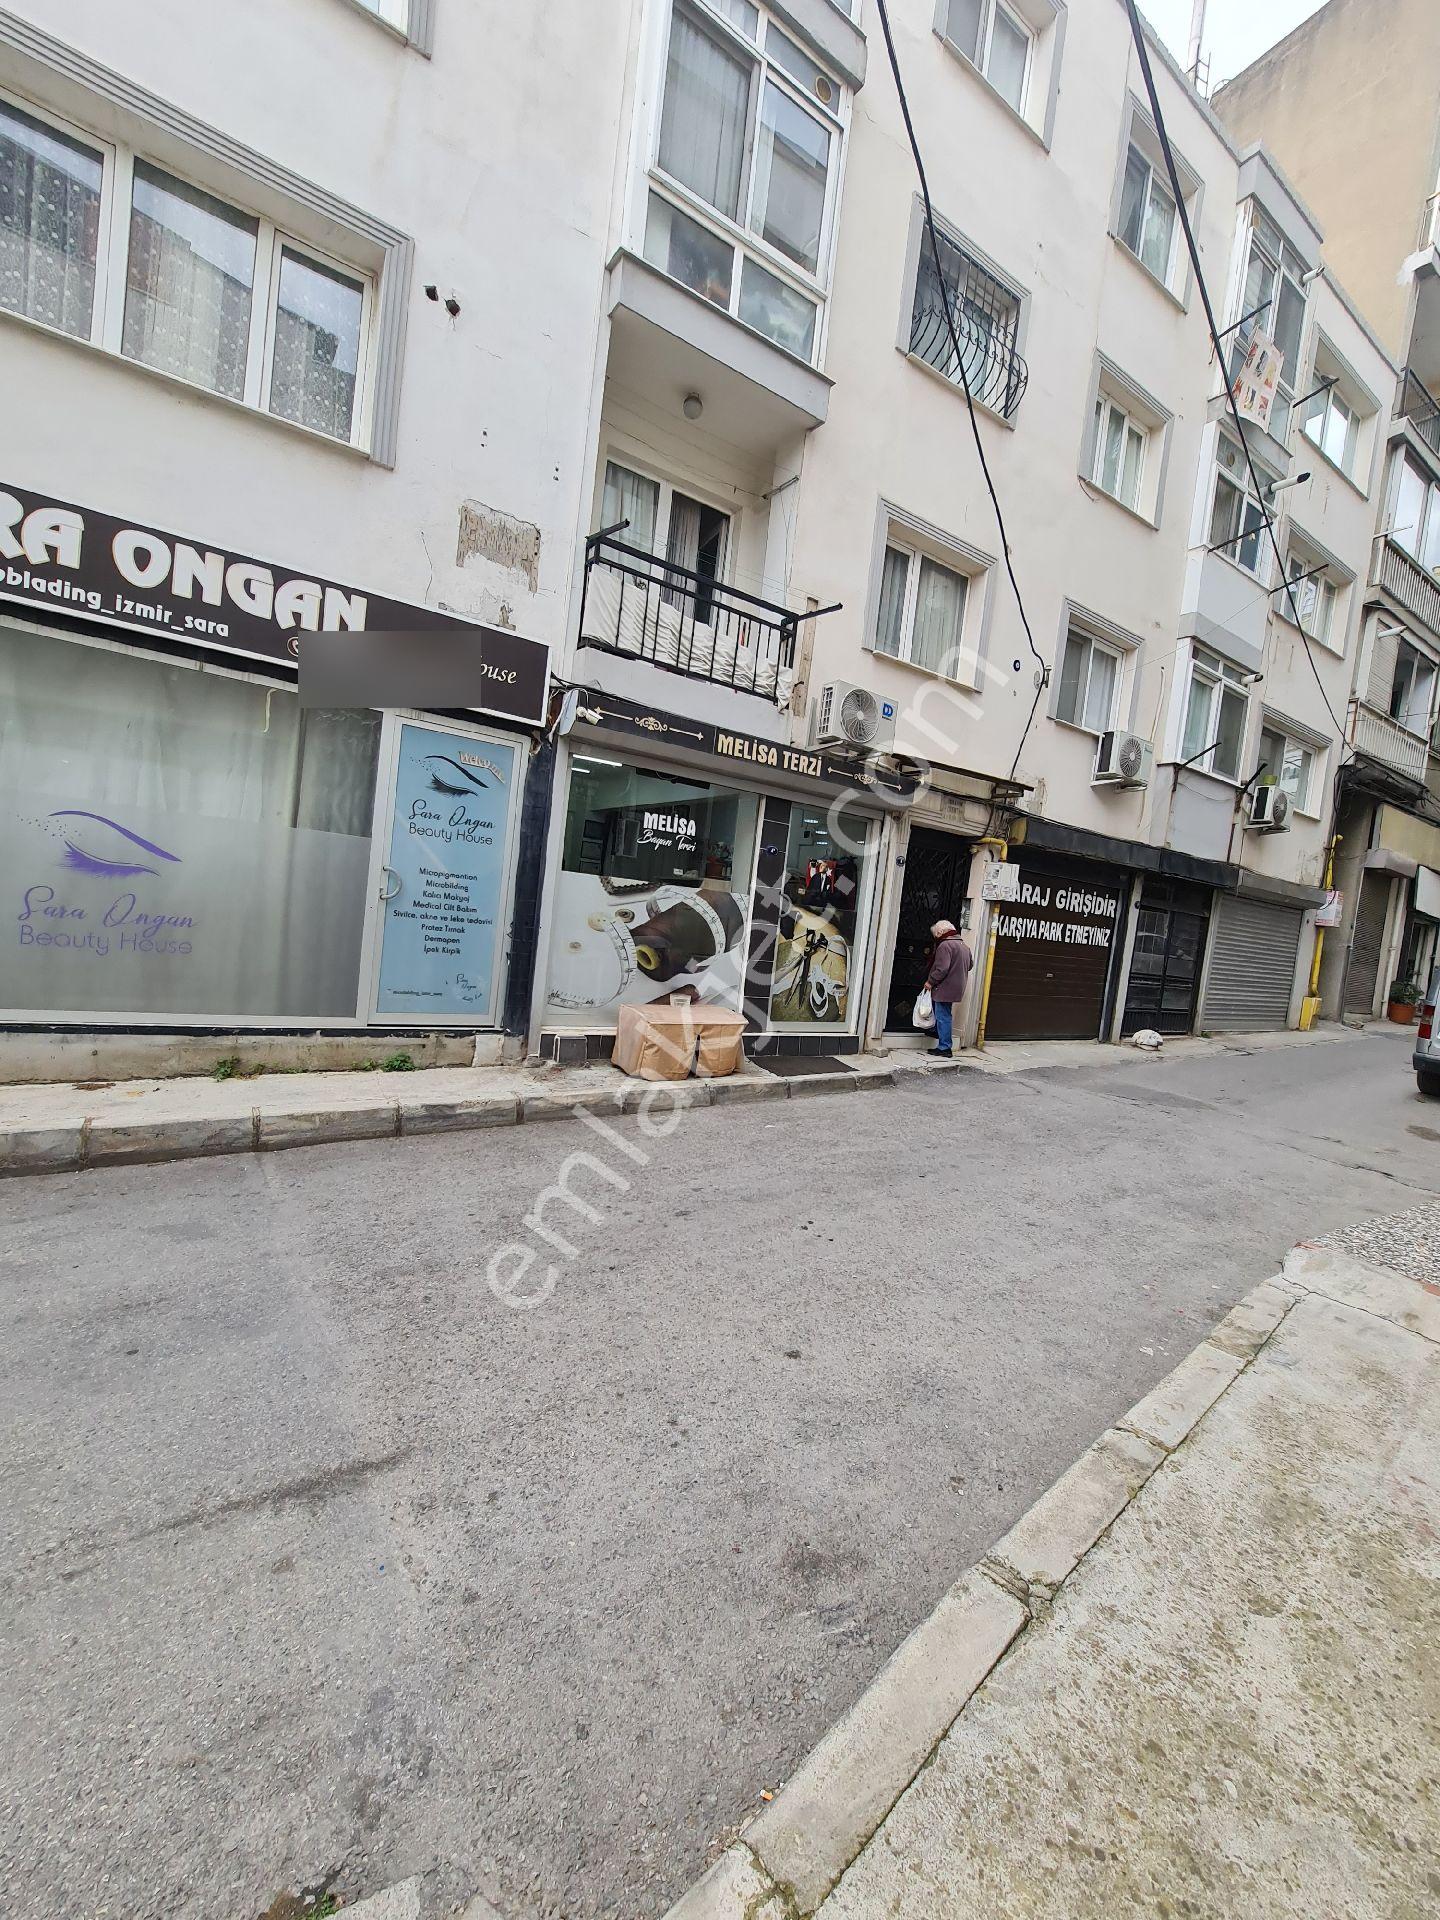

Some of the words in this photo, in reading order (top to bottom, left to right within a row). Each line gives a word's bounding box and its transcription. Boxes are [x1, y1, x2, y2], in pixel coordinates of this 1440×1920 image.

[112, 529, 368, 632] ONGAN
[480, 661, 517, 684] ouse
[717, 733, 778, 767] MELİSA
[782, 750, 822, 777] TERZİ
[408, 799, 441, 820] Sara
[448, 805, 495, 834] Ongan
[643, 811, 696, 837] MELİSA
[409, 821, 452, 843] Beauty
[456, 828, 493, 845] House
[636, 829, 673, 851] Bayan
[675, 834, 697, 852] Terzi
[17, 885, 88, 921] Sara
[103, 893, 199, 938] Ongan
[412, 899, 442, 910] Medical
[443, 903, 455, 912] Cilt
[443, 892, 470, 903] Makyaj
[1011, 881, 1051, 907] ARAJ
[1055, 886, 1117, 918] GİRİŞİDİR
[20, 924, 109, 956] Beauty
[120, 931, 193, 954] House
[424, 934, 461, 945] Dermapen
[997, 914, 1037, 943] KARŞIYA
[1037, 920, 1064, 942] PARK
[1064, 923, 1111, 947] ETMEYİNİZ
